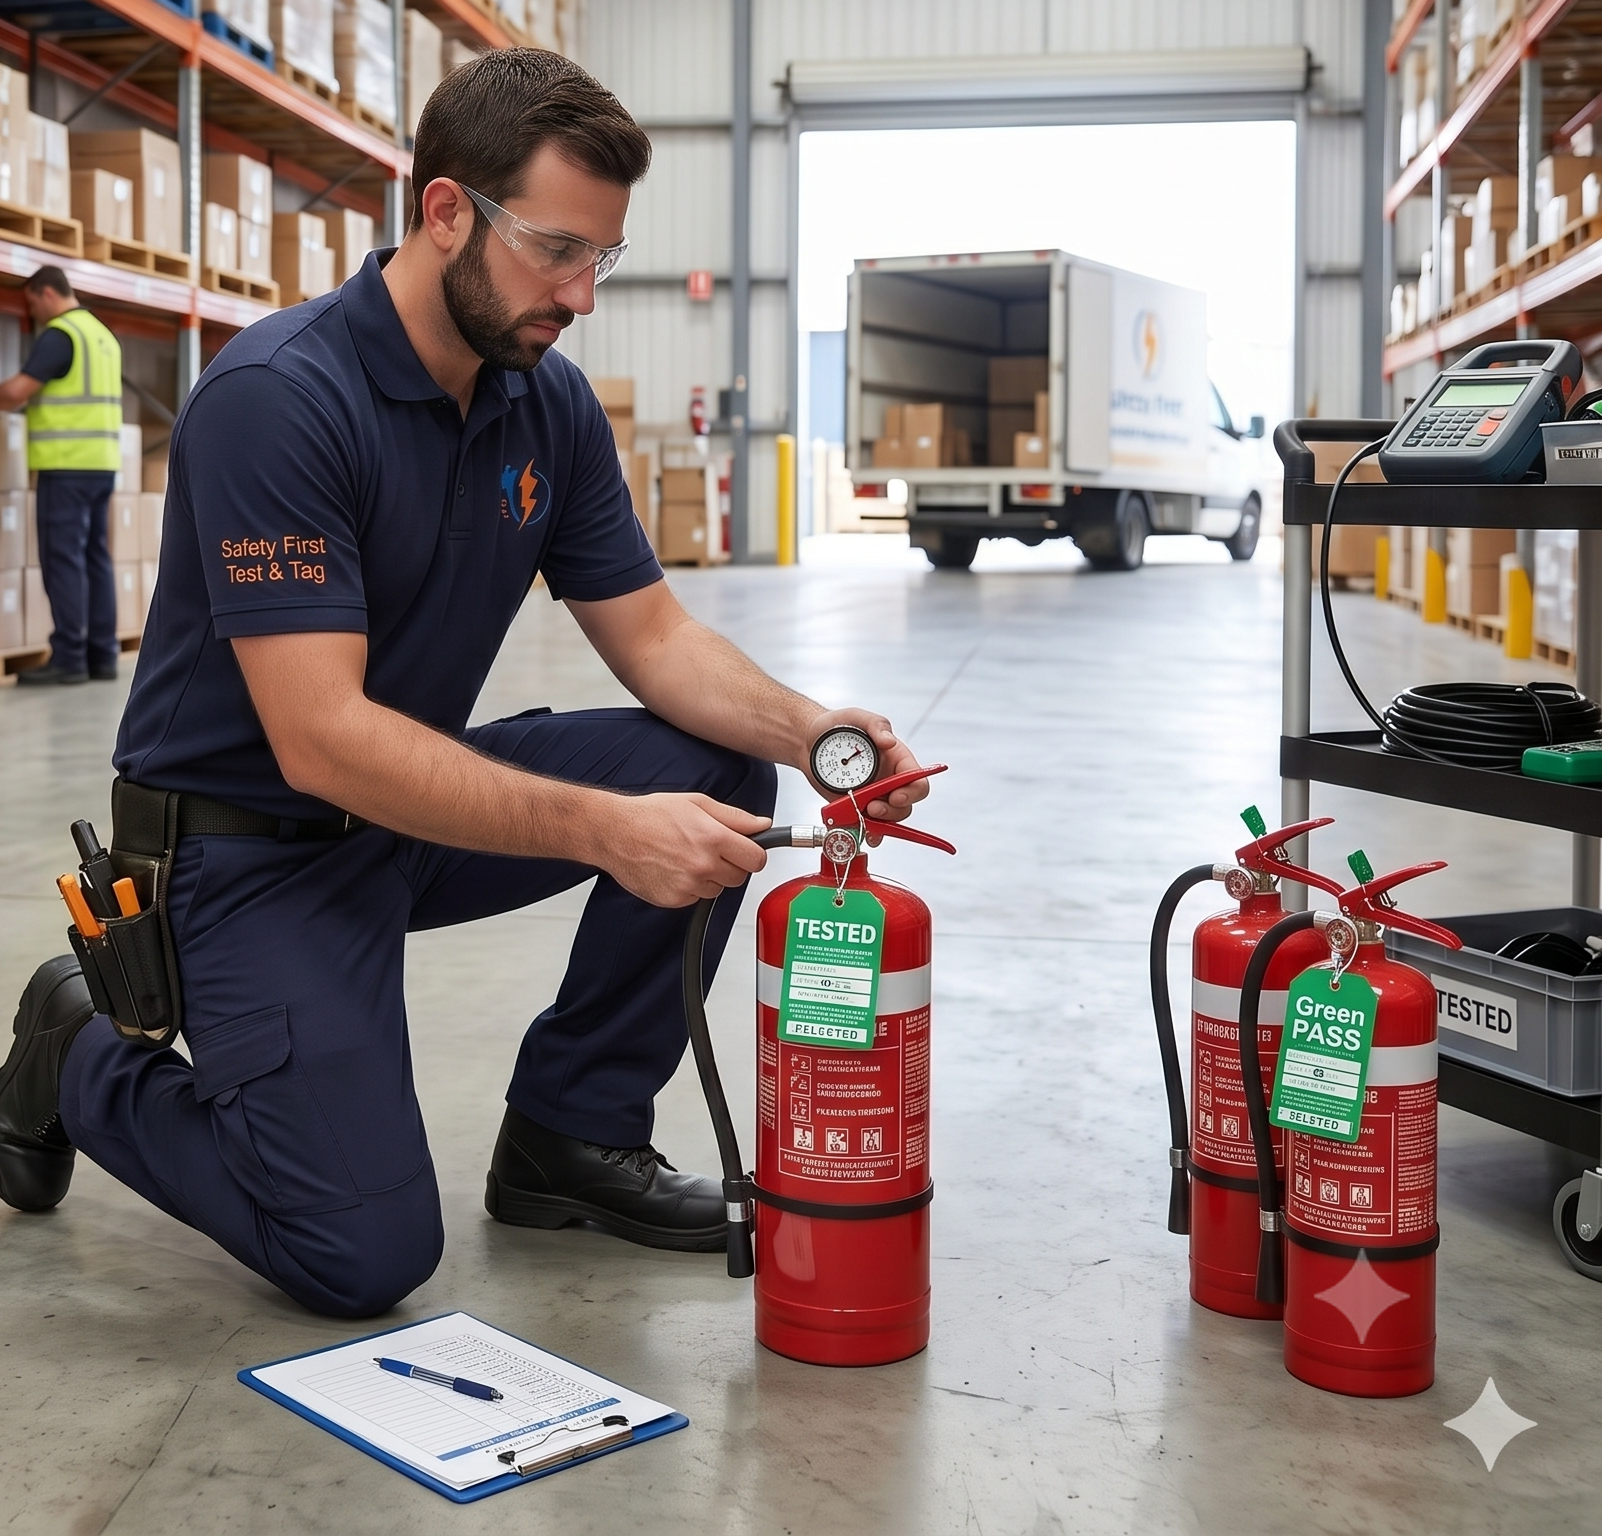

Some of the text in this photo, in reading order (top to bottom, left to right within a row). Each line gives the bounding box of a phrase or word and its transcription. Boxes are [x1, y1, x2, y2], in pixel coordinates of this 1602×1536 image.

[222, 536, 326, 560] Safety First
[226, 561, 325, 584] Test & Tag
[795, 918, 877, 945] TESTED
[1296, 996, 1365, 1027] Green
[1436, 989, 1512, 1034] TESTED
[1292, 1018, 1361, 1051] PASS
